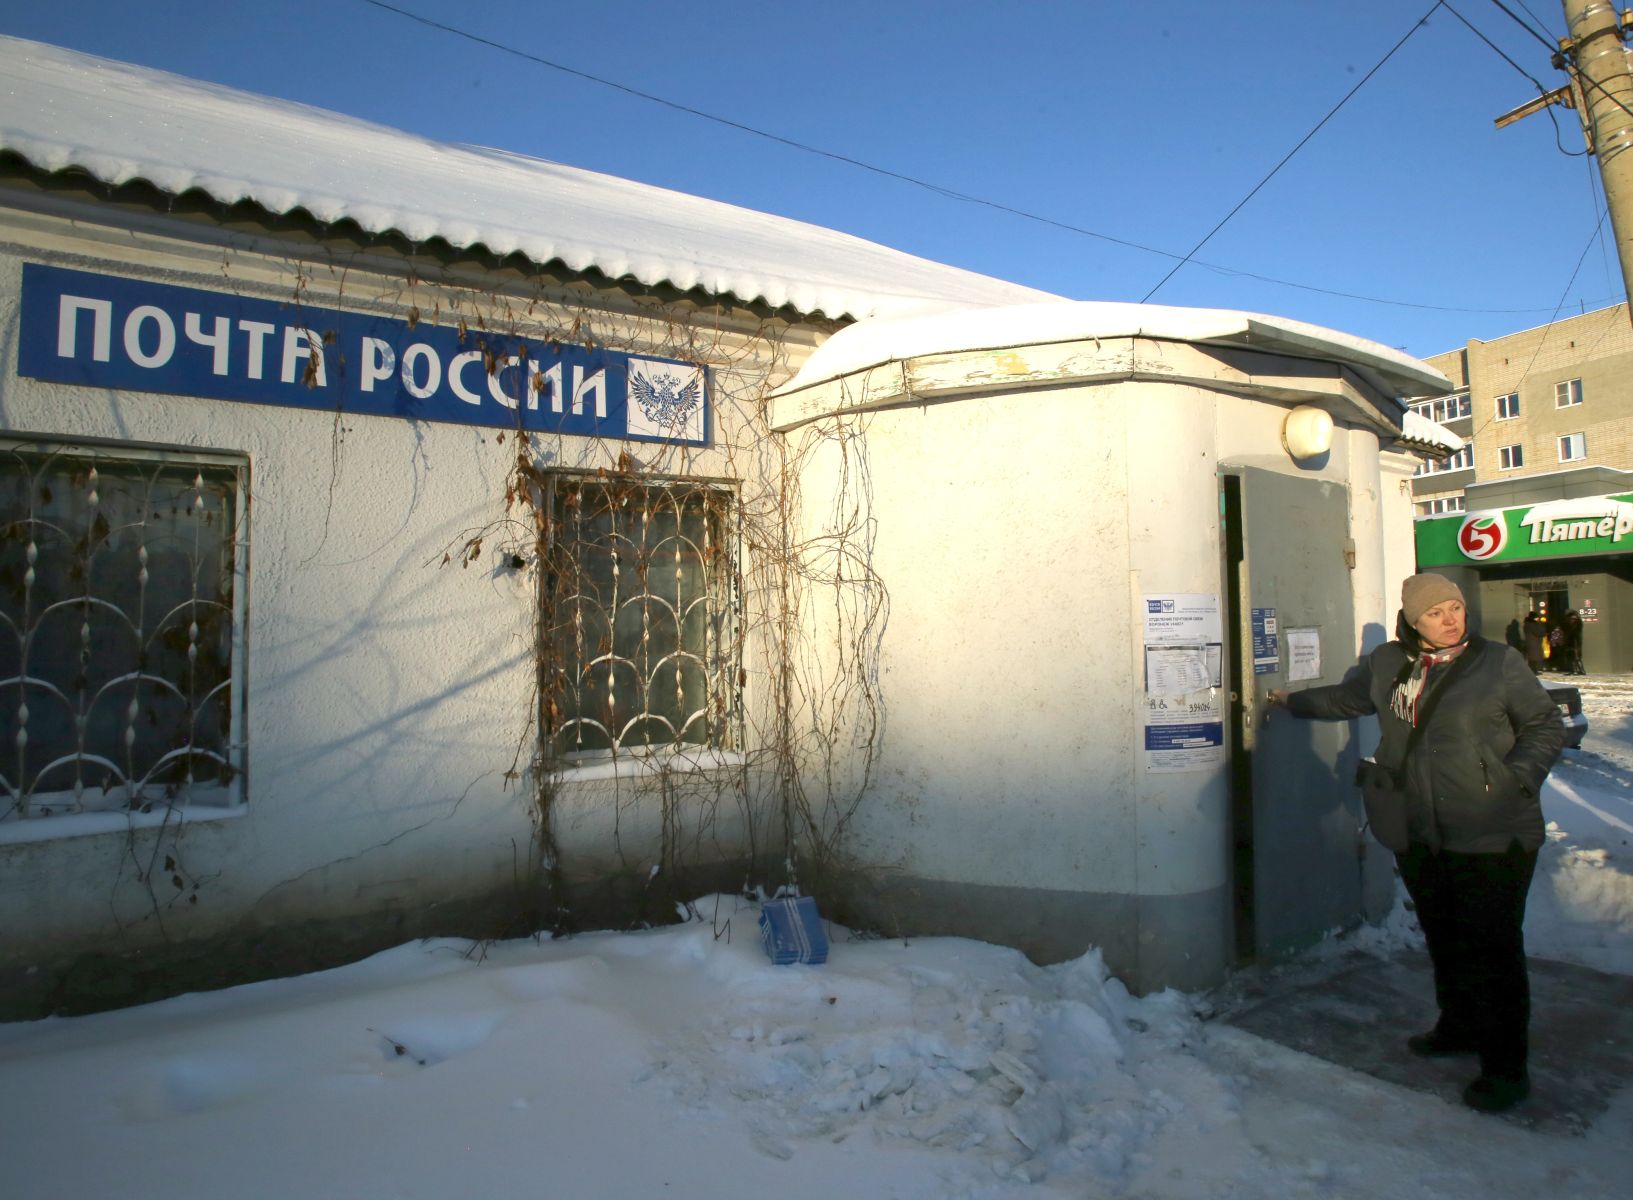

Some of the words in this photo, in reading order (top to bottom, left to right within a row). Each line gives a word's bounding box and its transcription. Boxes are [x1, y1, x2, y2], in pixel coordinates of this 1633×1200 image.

[57, 293, 328, 387] ПОЧТА
[360, 336, 607, 418] РОССИИ
[1466, 518, 1496, 556] 5
